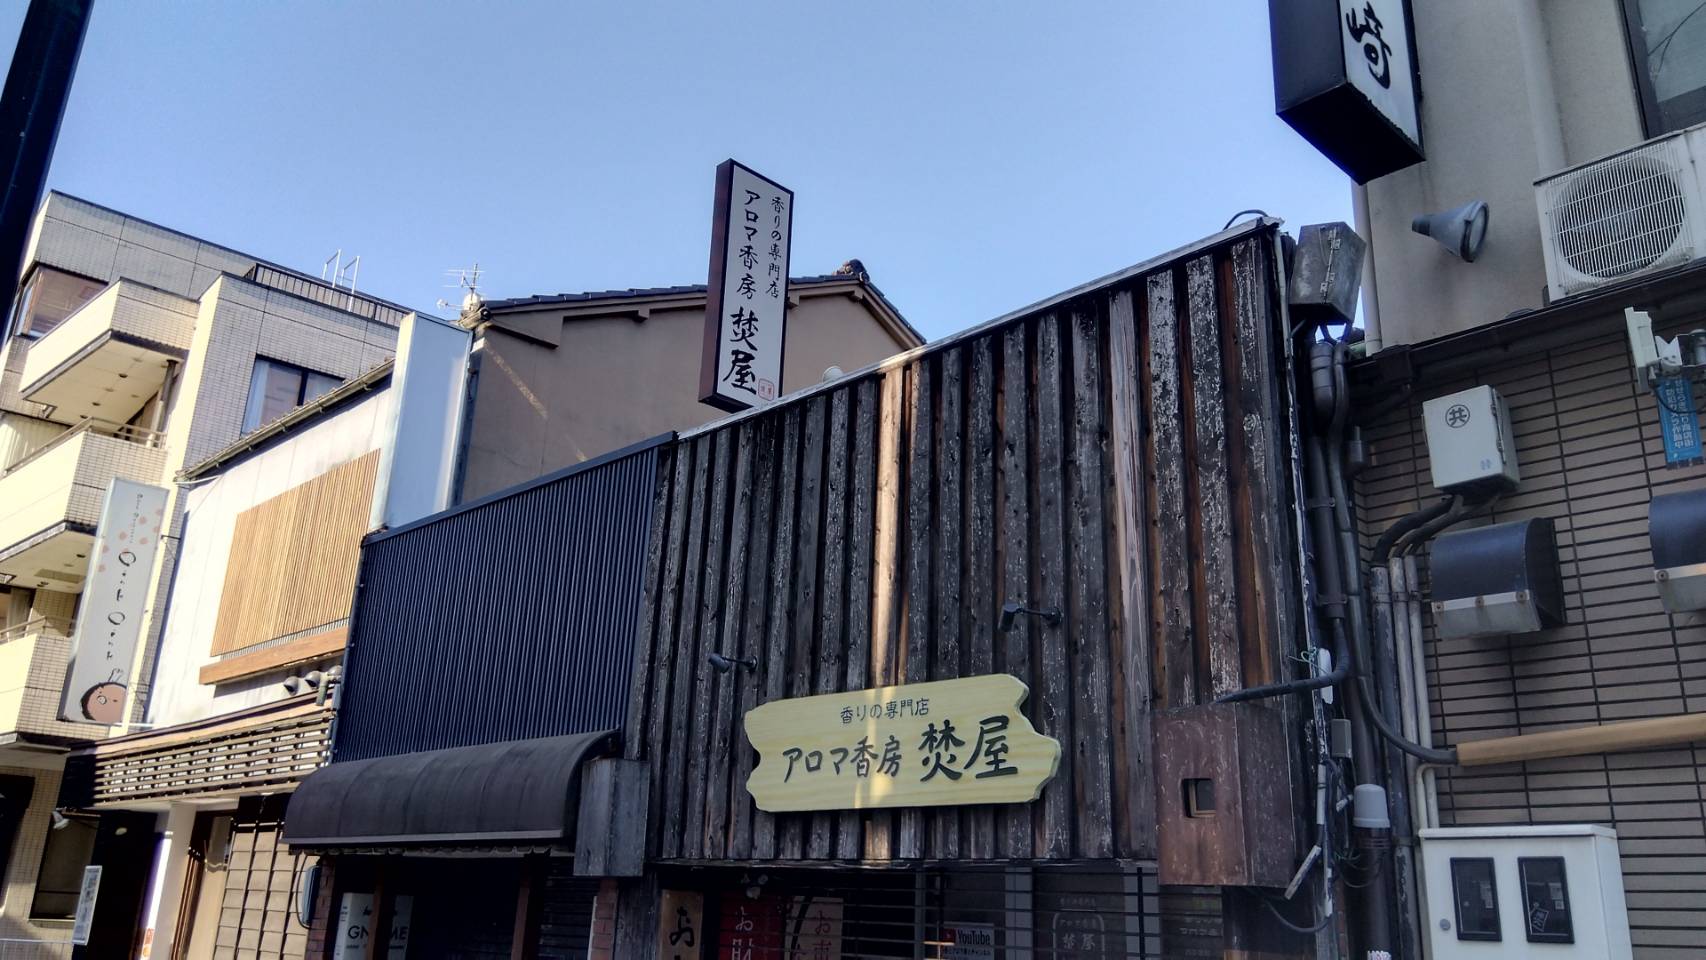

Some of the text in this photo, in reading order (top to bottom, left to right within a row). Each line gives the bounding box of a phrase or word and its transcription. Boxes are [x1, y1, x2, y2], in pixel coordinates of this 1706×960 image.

[765, 196, 785, 299] 香りの専門店
[723, 189, 761, 395] アロマ香房 焚屋
[839, 697, 930, 724] 香りの専門店
[782, 714, 1019, 784] アロマ香房 焚屋
[957, 929, 991, 945] YouTube
